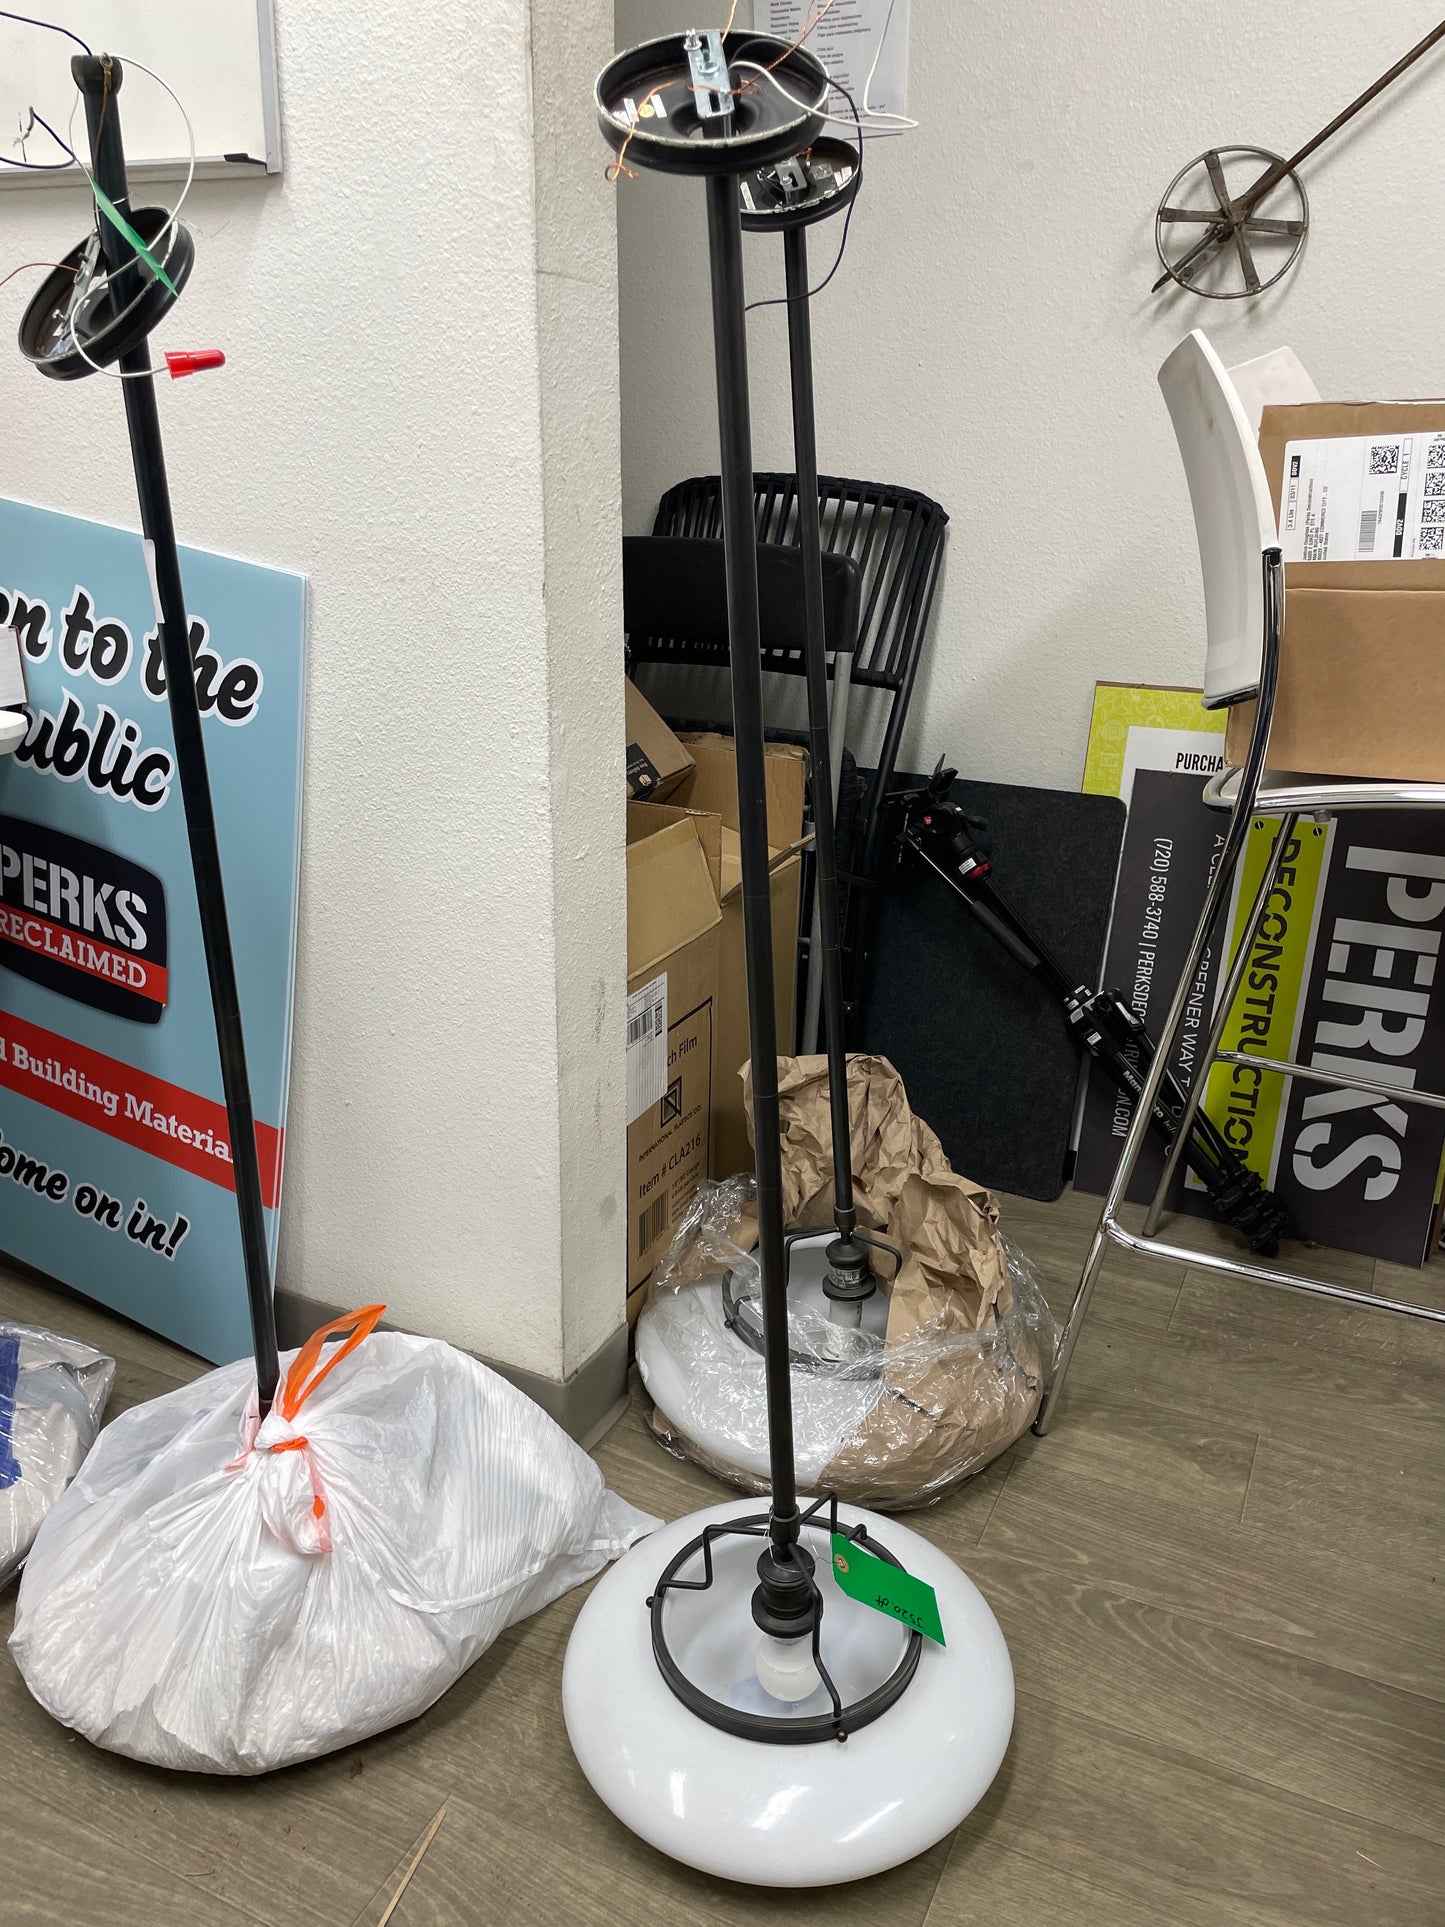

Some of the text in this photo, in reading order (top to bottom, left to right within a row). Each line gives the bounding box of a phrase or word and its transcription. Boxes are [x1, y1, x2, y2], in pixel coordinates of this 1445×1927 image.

[1401, 460, 1409, 480] CYCLE
[65, 591, 128, 680] to
[145, 621, 258, 720] the
[14, 697, 171, 806] ublic
[1175, 752, 1224, 772] PURCHA
[1149, 838, 1174, 872] (720)
[0, 844, 148, 950] PERKS
[1142, 876, 1168, 940] 588-3740
[0, 908, 147, 988] RECLAIMED
[678, 1036, 698, 1058] Film
[1178, 1034, 1198, 1073] WAY
[1293, 845, 1445, 1201] PERKS
[12, 1042, 234, 1164] Building Materia
[0, 1146, 188, 1258] ome on in!
[639, 1173, 659, 1199] Item
[661, 1164, 667, 1177] #
[668, 1132, 701, 1171] CLA216
